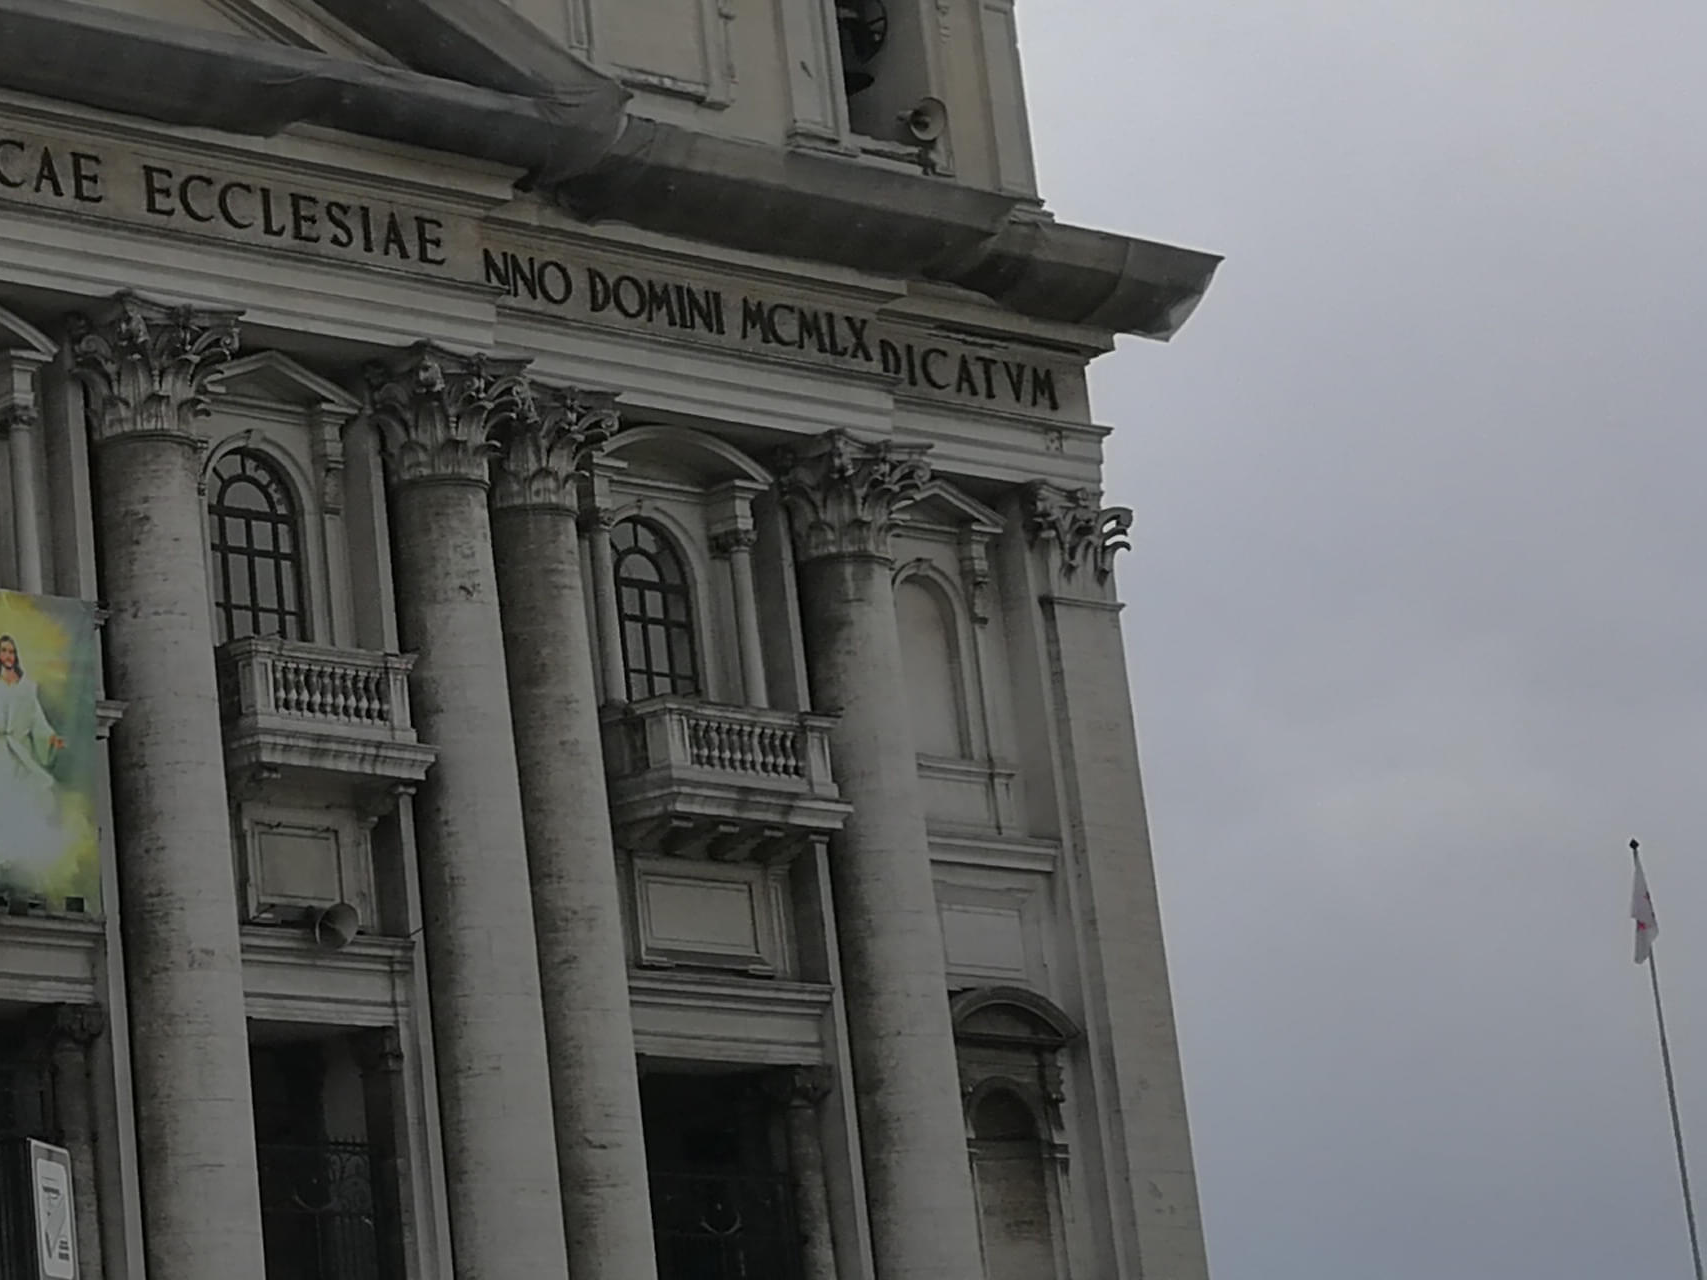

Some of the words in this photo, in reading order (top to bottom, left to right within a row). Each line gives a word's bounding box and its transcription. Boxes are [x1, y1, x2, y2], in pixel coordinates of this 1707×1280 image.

[142, 163, 447, 266] ECCLESIAE
[587, 267, 726, 336] DOMINI
[741, 295, 874, 362] MCMLX
